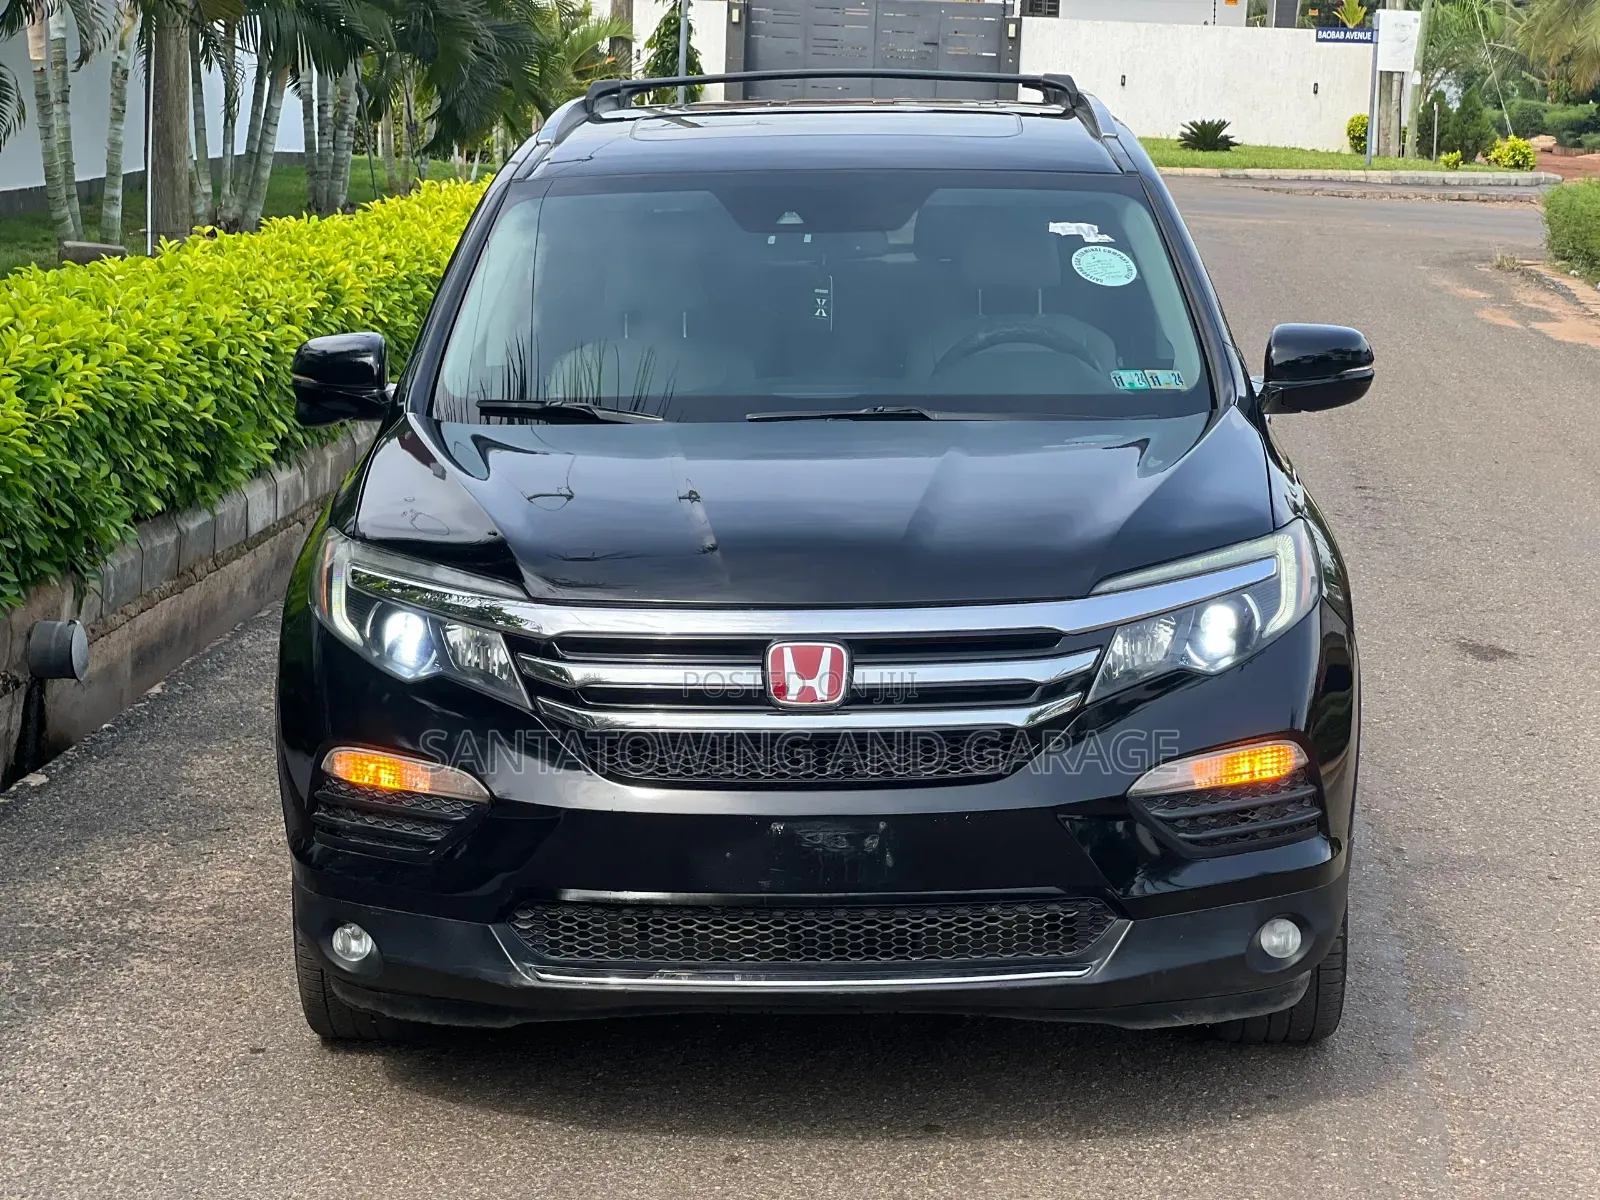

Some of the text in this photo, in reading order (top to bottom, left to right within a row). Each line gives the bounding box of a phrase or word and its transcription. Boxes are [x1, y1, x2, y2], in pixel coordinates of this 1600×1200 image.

[1317, 31, 1371, 39] BAOBAB AVENUE
[1103, 249, 1130, 264] COMPANY
[1113, 375, 1125, 387] 11
[1150, 373, 1184, 387] 11 24
